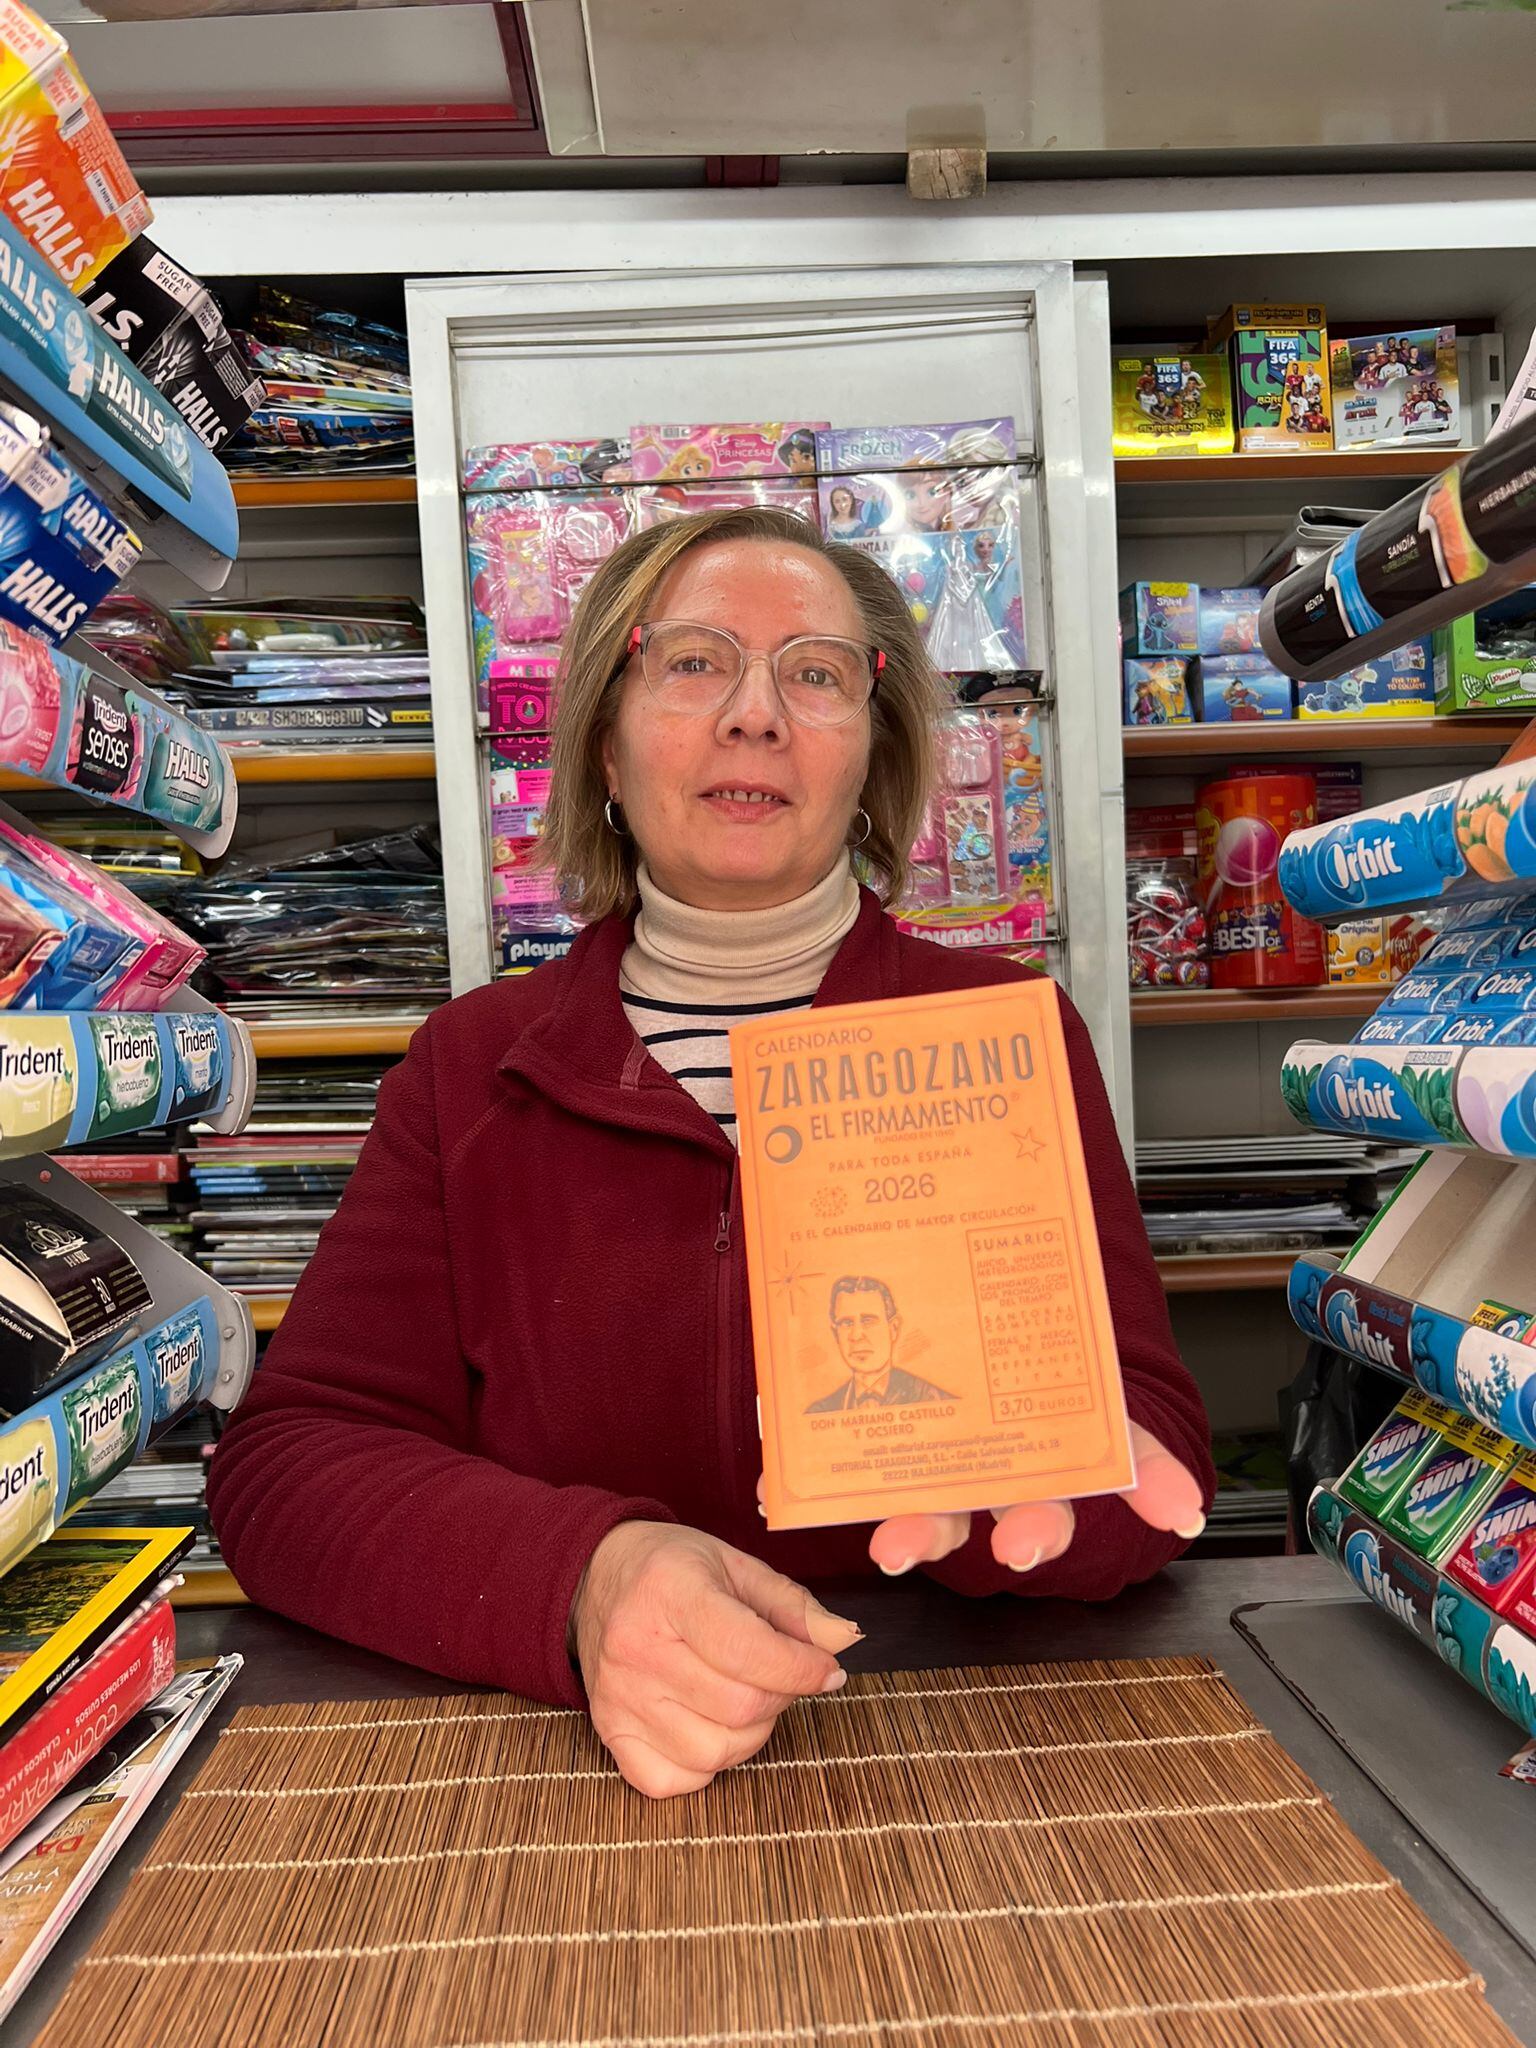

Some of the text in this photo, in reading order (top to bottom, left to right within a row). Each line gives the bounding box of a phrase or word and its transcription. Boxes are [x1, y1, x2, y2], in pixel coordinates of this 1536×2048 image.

[4, 8, 46, 51] SUGAR
[8, 178, 94, 281] HALLS
[156, 274, 181, 296] FREE
[158, 261, 192, 292] SUGAR
[200, 312, 211, 330] FREE
[202, 301, 218, 327] SUGAR
[1268, 341, 1297, 351] FIFA
[1269, 353, 1297, 364] 365
[1156, 366, 1178, 374] FIFA
[1158, 374, 1179, 383] 365
[99, 352, 165, 446] HALLS
[172, 380, 228, 450] HALLS
[719, 448, 773, 458] PRINCESAS
[840, 440, 902, 458] FROZEN
[25, 473, 45, 496] FREE
[32, 459, 57, 487] SUGAR
[64, 494, 126, 558] HALLS
[1387, 534, 1417, 560] SANDÍA
[1304, 594, 1325, 613] MENTA
[93, 695, 128, 732] Trident
[272, 708, 363, 728] MEGACRACKS
[85, 727, 130, 769] senses
[163, 740, 210, 788] HALLS
[1325, 836, 1403, 889] Orbit
[1216, 925, 1281, 951] BEST OF
[1340, 924, 1381, 935] Original
[1393, 972, 1532, 1000] Orbit Orbit
[178, 1028, 216, 1056] Trident
[755, 1027, 873, 1058] CALENDARIO
[1360, 1019, 1494, 1043] Orbit Orbit
[105, 1034, 154, 1066] Trident
[757, 1033, 1034, 1113] ZARAGOZANO
[1326, 1073, 1402, 1121] Orbit
[810, 1094, 1009, 1141] EL FIRMAMENTO
[829, 1146, 973, 1173] PARA TODA ESPAÑA
[864, 1172, 936, 1204] 2026
[790, 1203, 1037, 1243] ES EL CALENDARIO DE MAYOR CIRCULACIÓN
[973, 1231, 1062, 1252] SUMARIO:
[979, 1272, 1069, 1292] CALENDARIO CON
[1000, 1298, 1016, 1308] DEL
[157, 1338, 198, 1385] Trident
[79, 1386, 134, 1447] Trident
[810, 1406, 956, 1432] DON MARIANO CASTILLO
[1000, 1394, 1086, 1417] 3,70 EUROS
[853, 1423, 914, 1440] Y OCSIERO
[128, 1658, 142, 1676] LOS
[99, 1669, 131, 1704] MEJORES
[75, 1696, 102, 1728] GUISOS
[50, 1702, 118, 1781] COCINA
